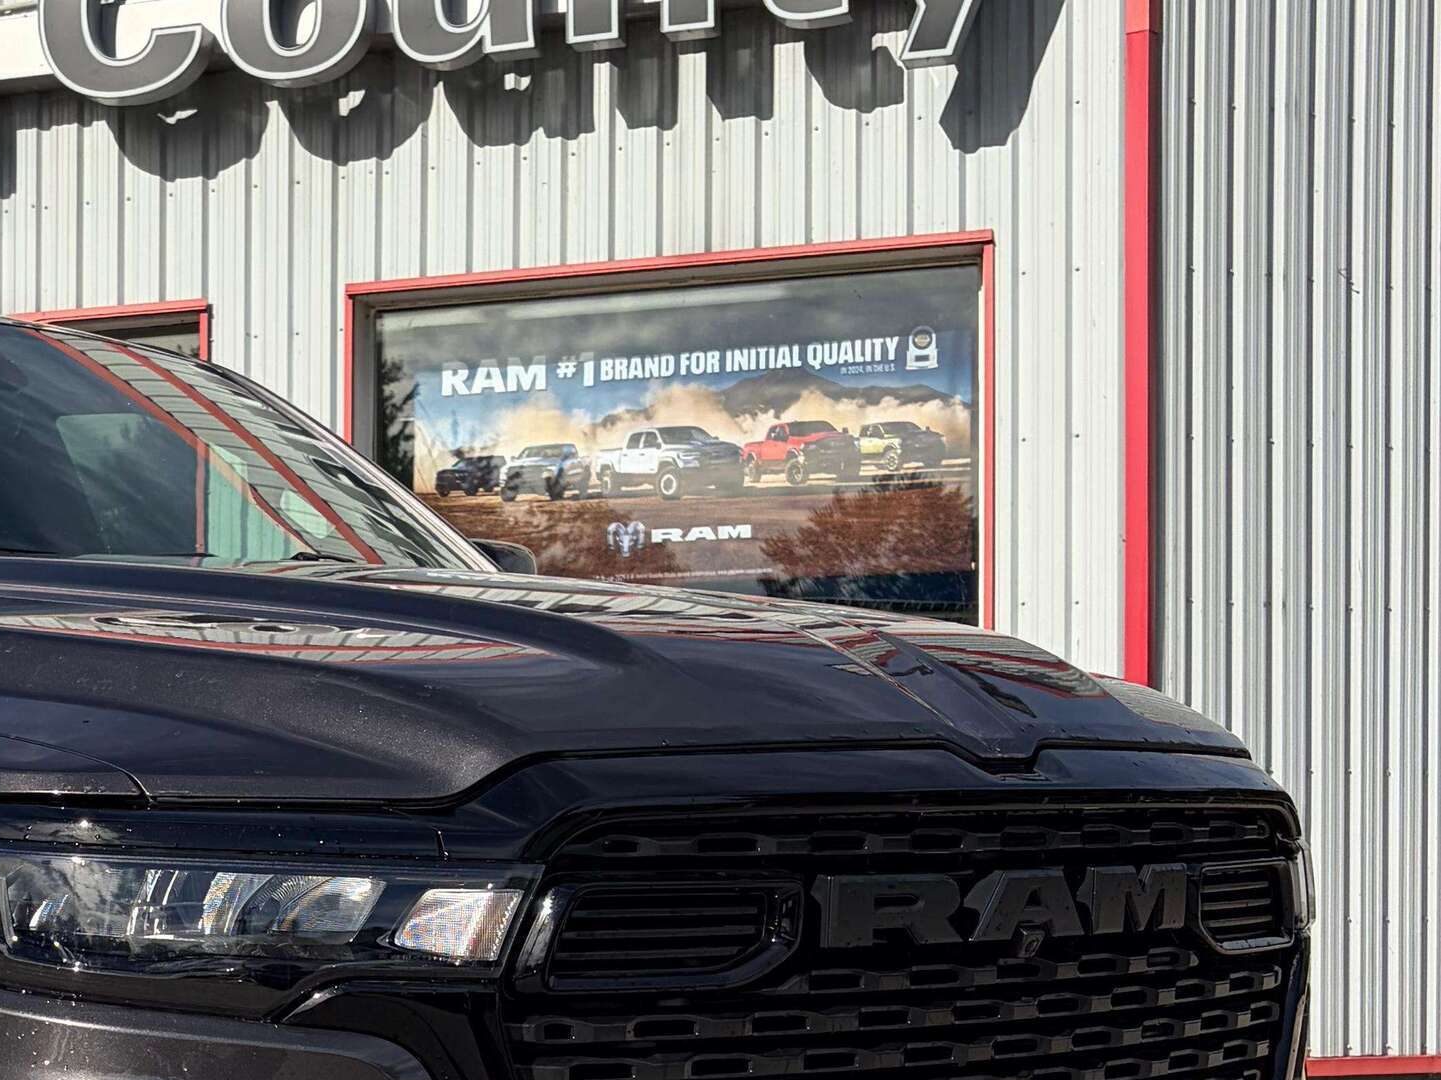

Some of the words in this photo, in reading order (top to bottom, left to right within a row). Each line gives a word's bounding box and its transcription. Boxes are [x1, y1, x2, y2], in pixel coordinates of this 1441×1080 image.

[441, 356, 547, 397] RAM
[556, 352, 595, 387] #1
[600, 354, 675, 382] BRAND
[679, 350, 721, 376] FOR
[725, 344, 802, 373] INITIAL
[807, 336, 899, 371] QUALITY
[651, 524, 753, 543] RAM
[812, 862, 1188, 948] RAM
